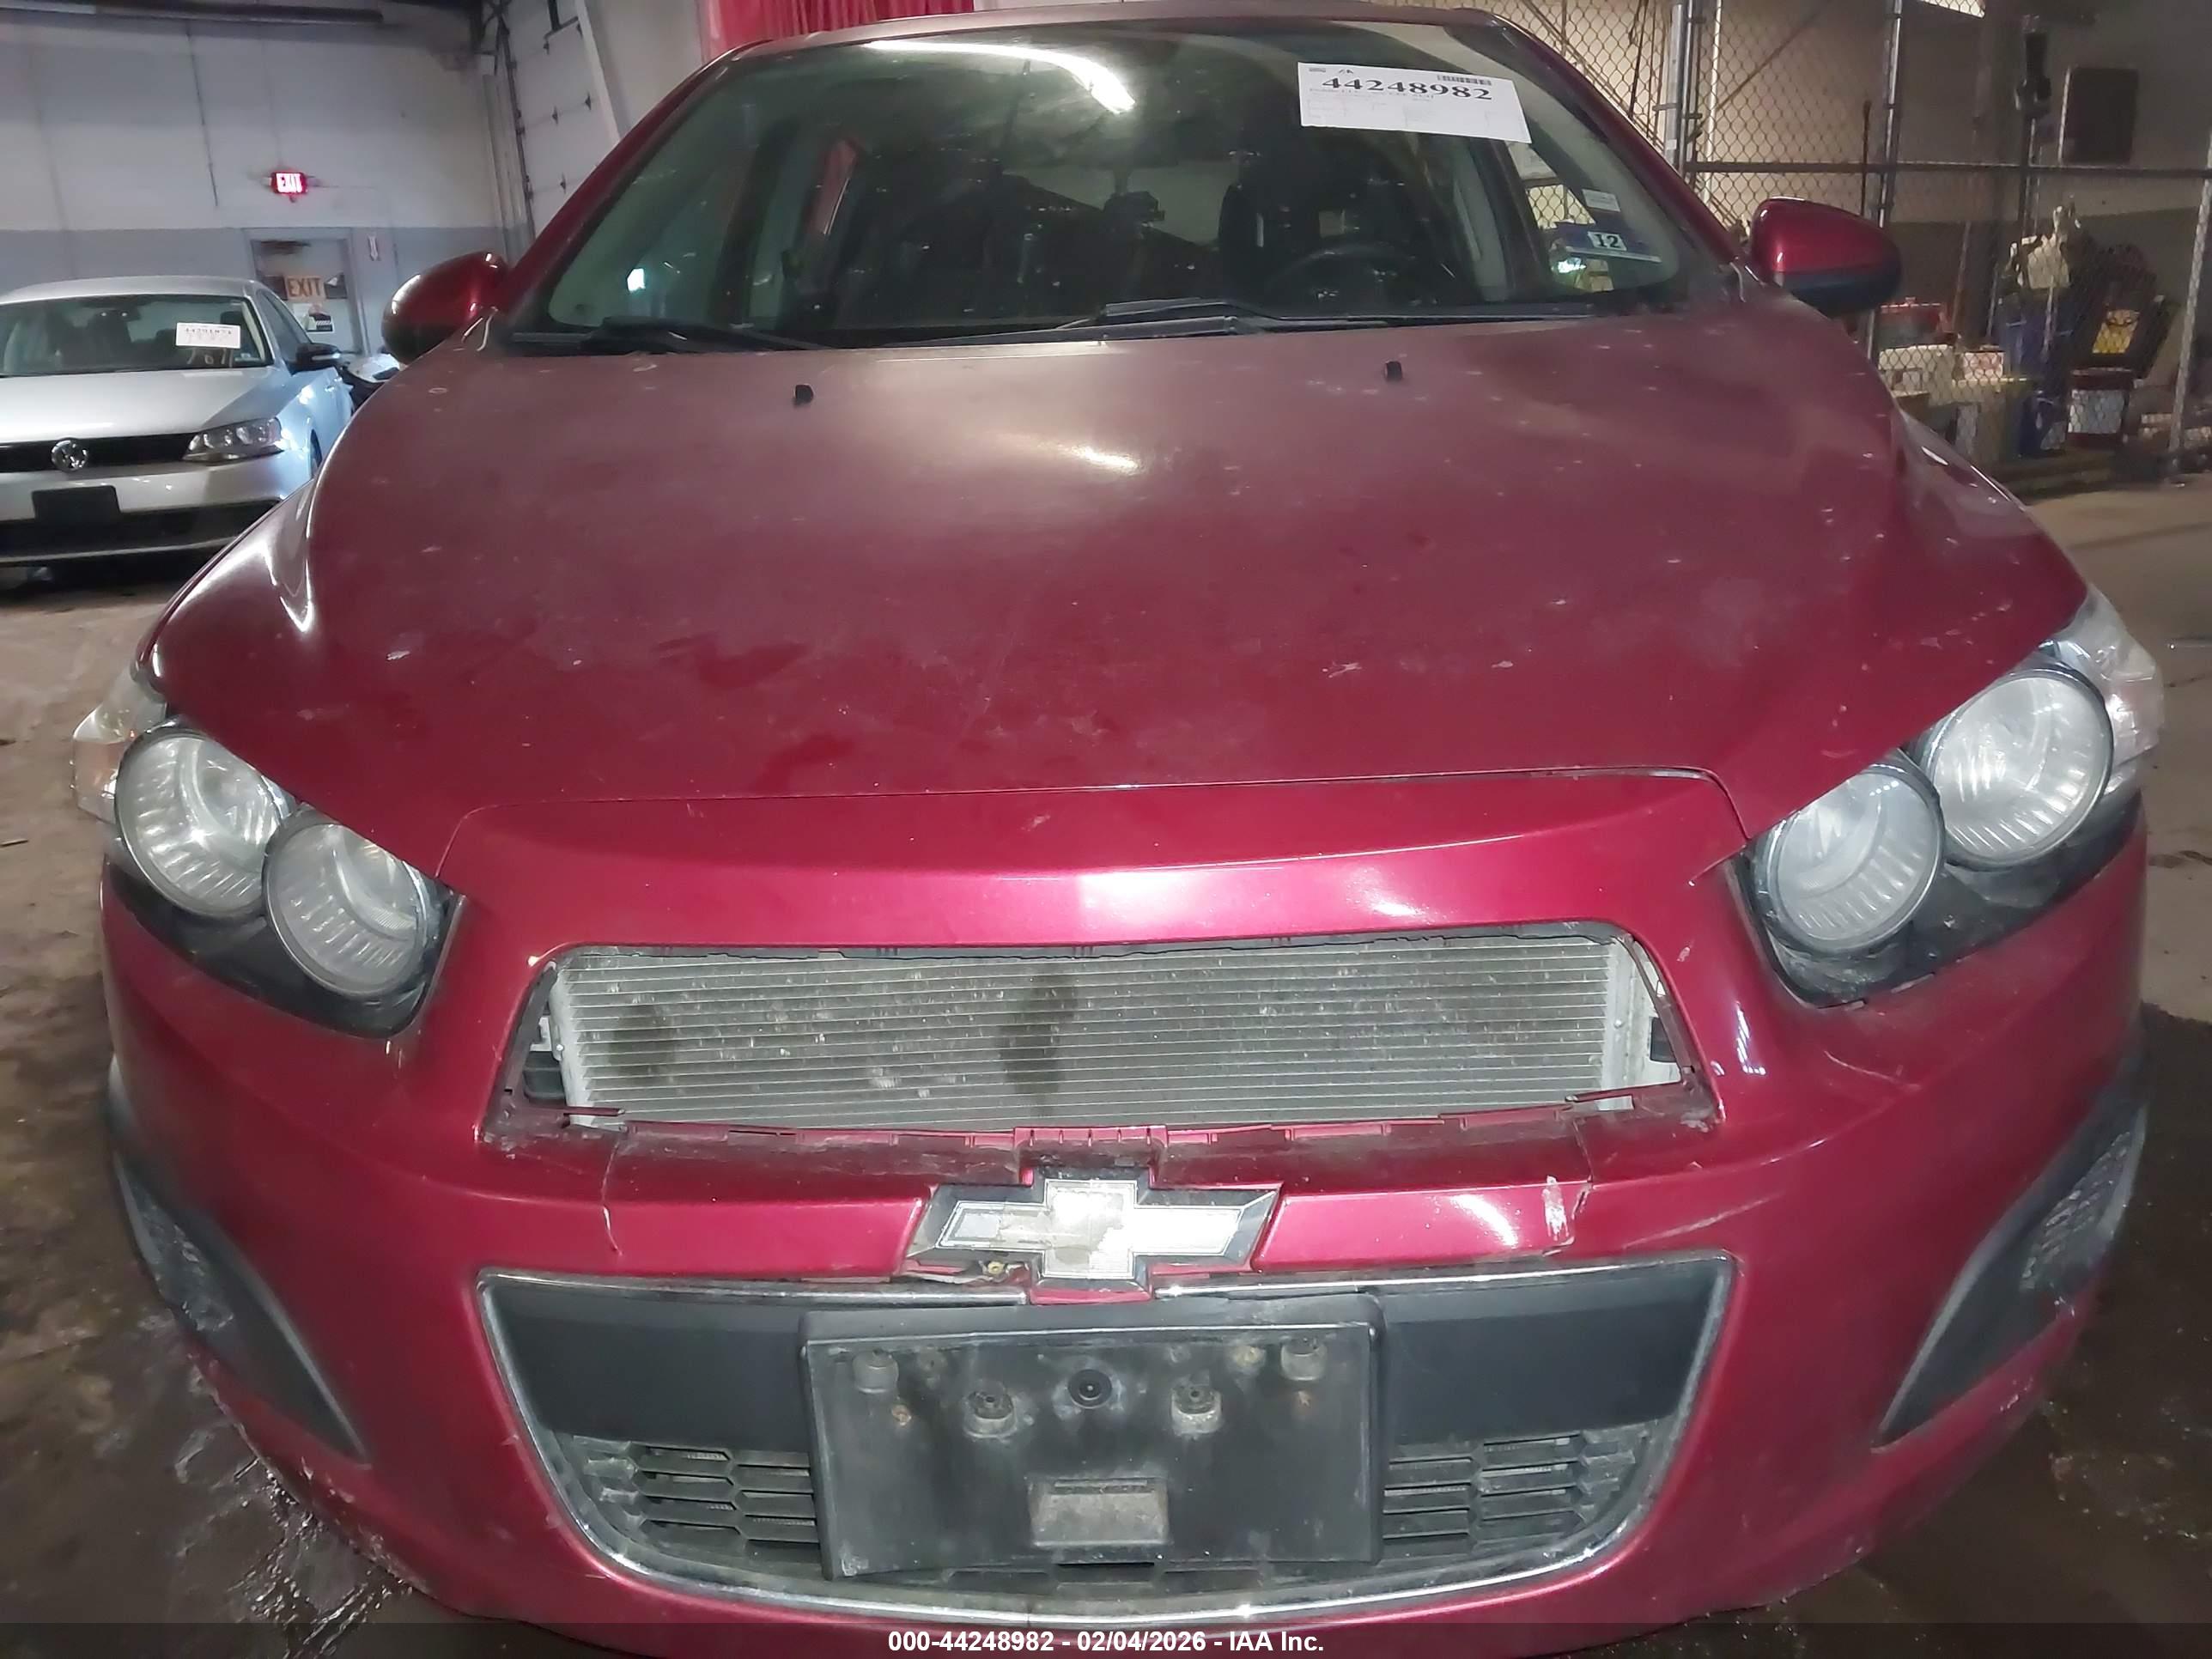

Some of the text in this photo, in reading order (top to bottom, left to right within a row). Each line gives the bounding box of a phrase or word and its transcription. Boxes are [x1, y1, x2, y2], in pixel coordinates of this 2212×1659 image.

[1322, 77, 1492, 100] 44248982
[276, 173, 302, 193] EXIT
[1595, 234, 1621, 248] 12
[288, 277, 321, 297] EXIT
